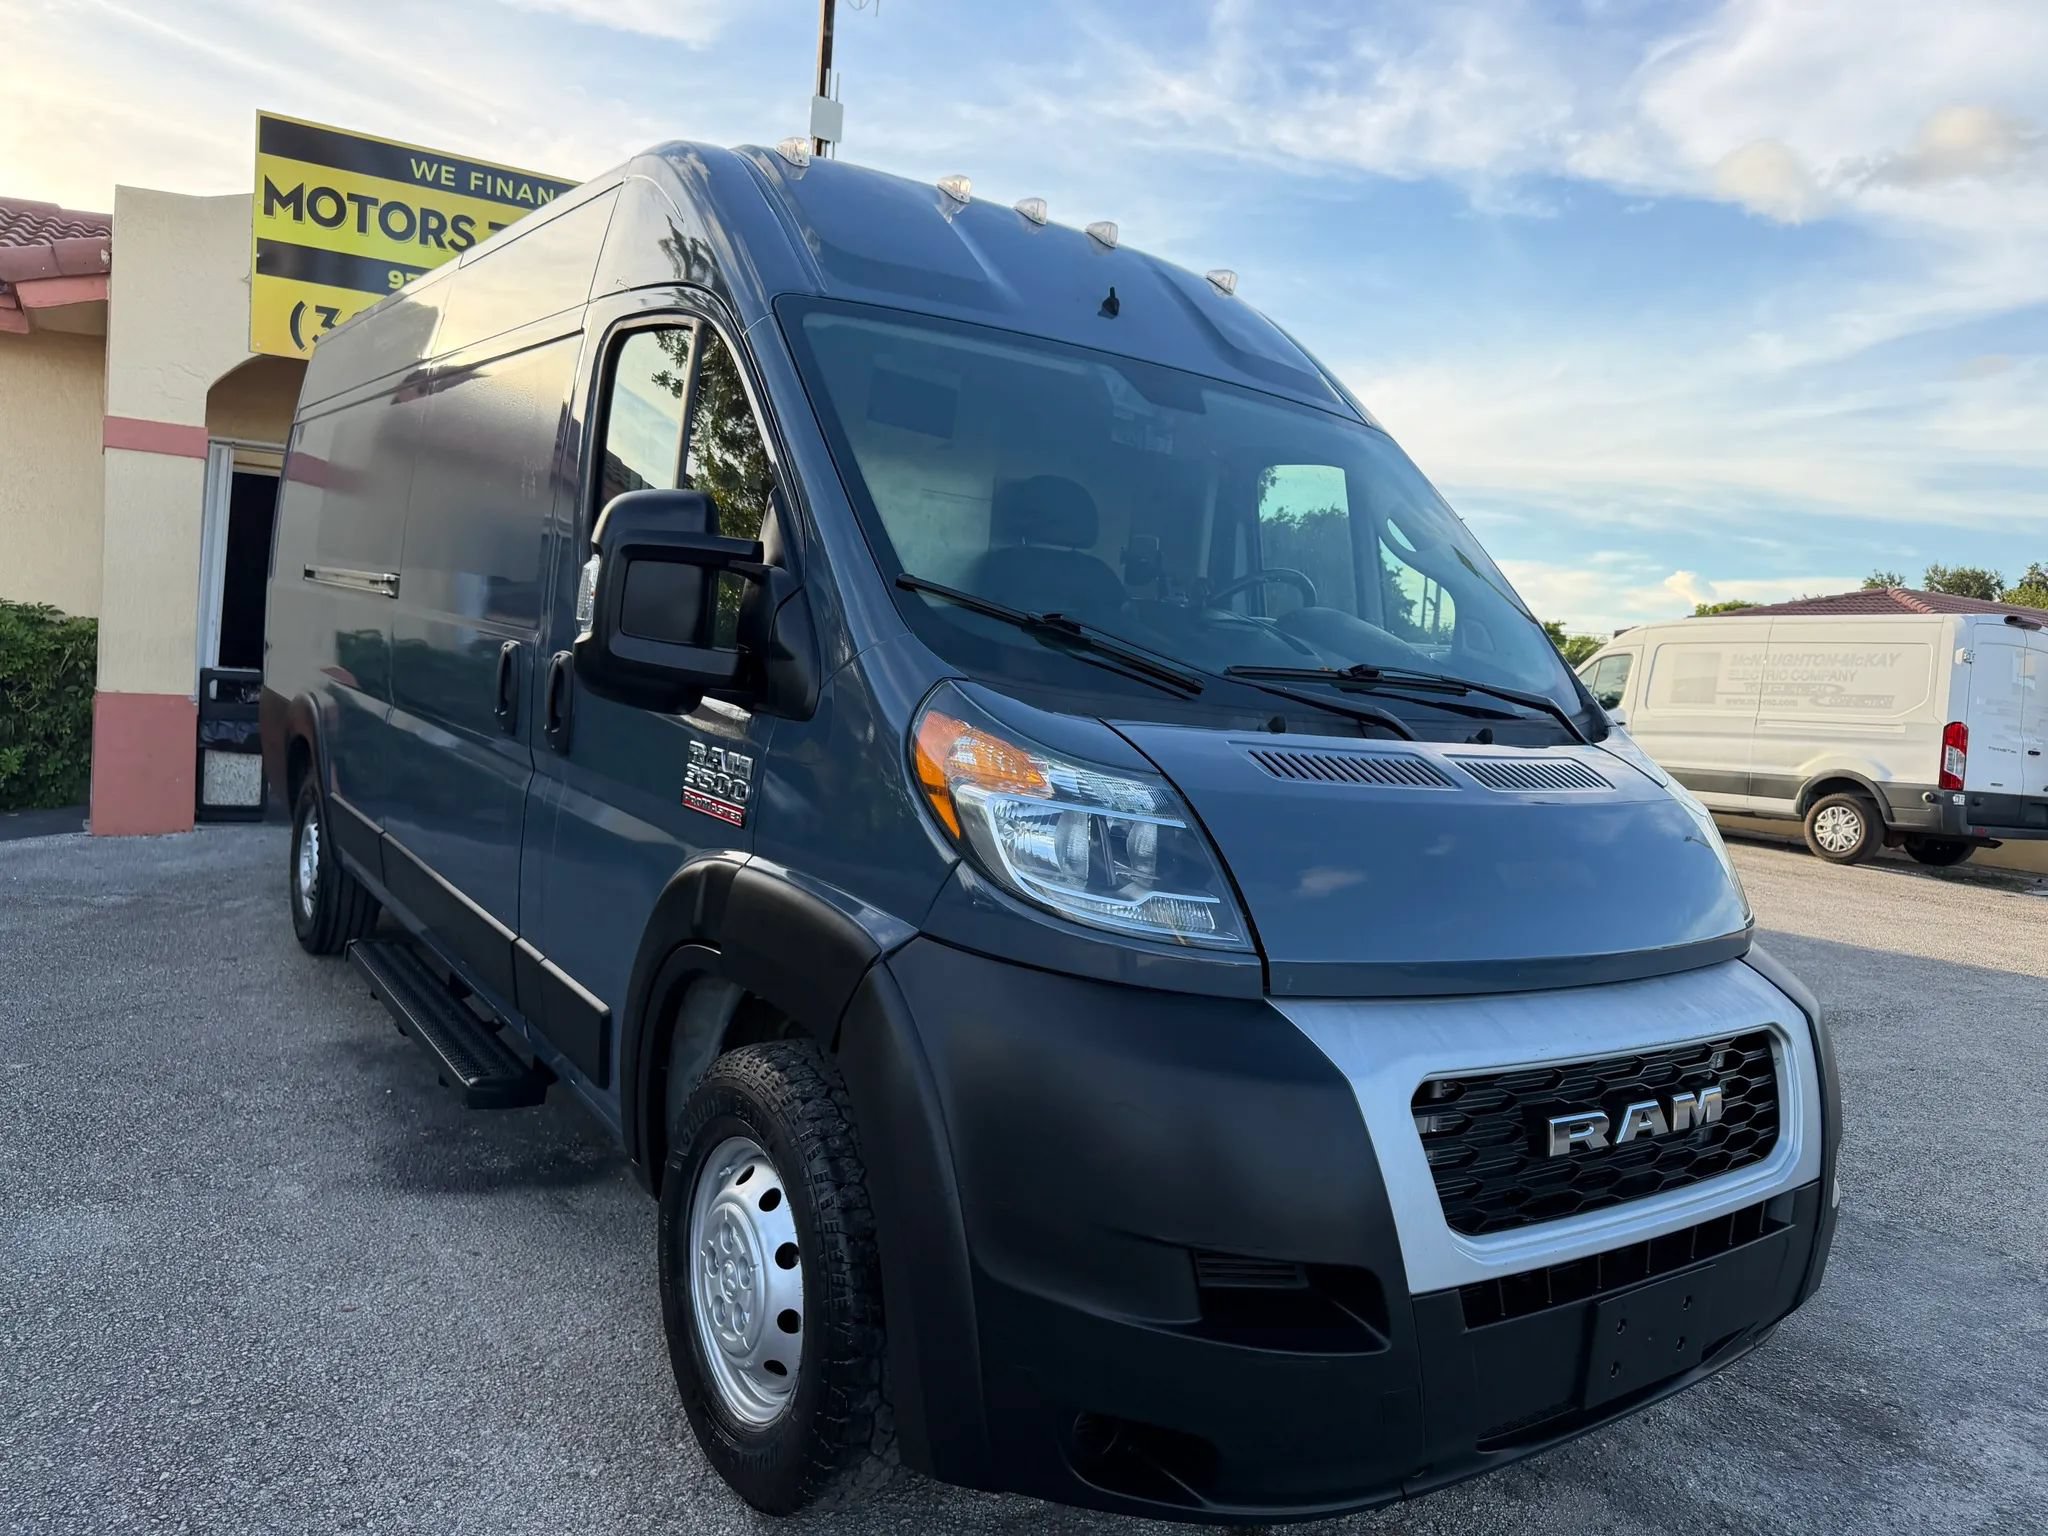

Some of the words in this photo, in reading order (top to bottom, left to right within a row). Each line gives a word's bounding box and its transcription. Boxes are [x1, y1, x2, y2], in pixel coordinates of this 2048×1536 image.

[410, 158, 456, 187] WE
[469, 171, 566, 206] FINAN
[263, 173, 477, 253] MOTORS
[1790, 669, 1858, 682] COMPANY
[687, 740, 753, 781] RAM
[1549, 1086, 1722, 1157] RAM
